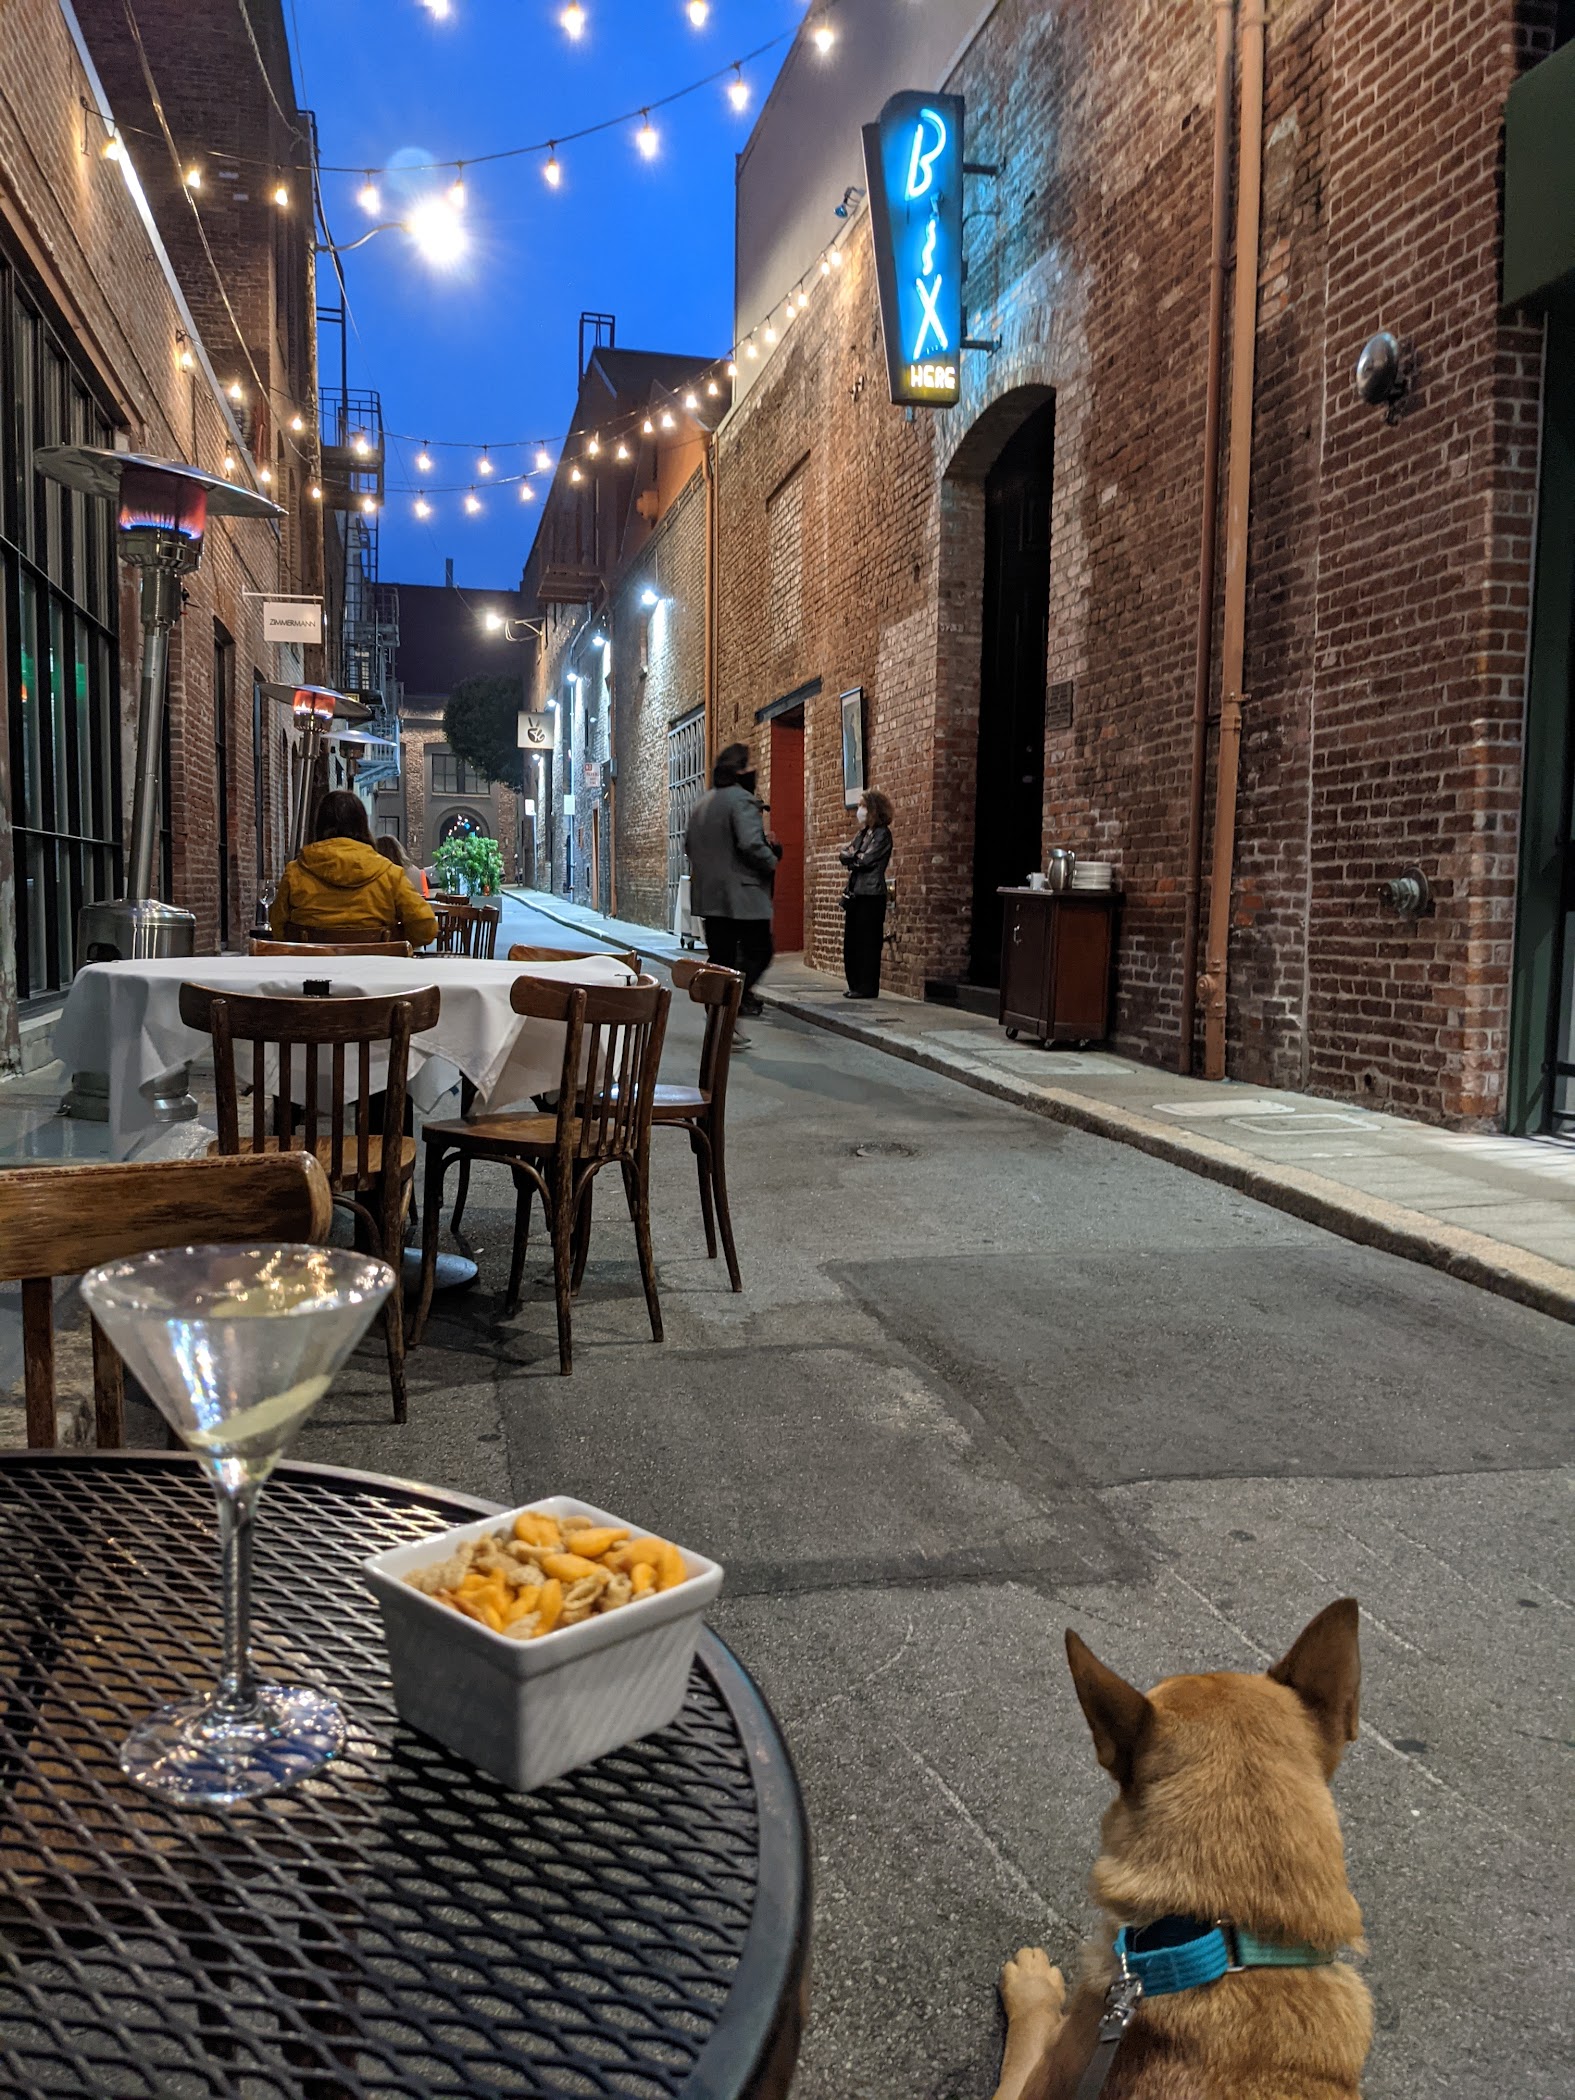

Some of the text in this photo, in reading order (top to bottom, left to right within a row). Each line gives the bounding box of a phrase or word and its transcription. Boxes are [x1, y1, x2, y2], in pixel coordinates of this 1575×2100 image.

[905, 109, 947, 361] BIX
[910, 364, 956, 389] HERE
[269, 618, 316, 627] ZIMMERMANN
